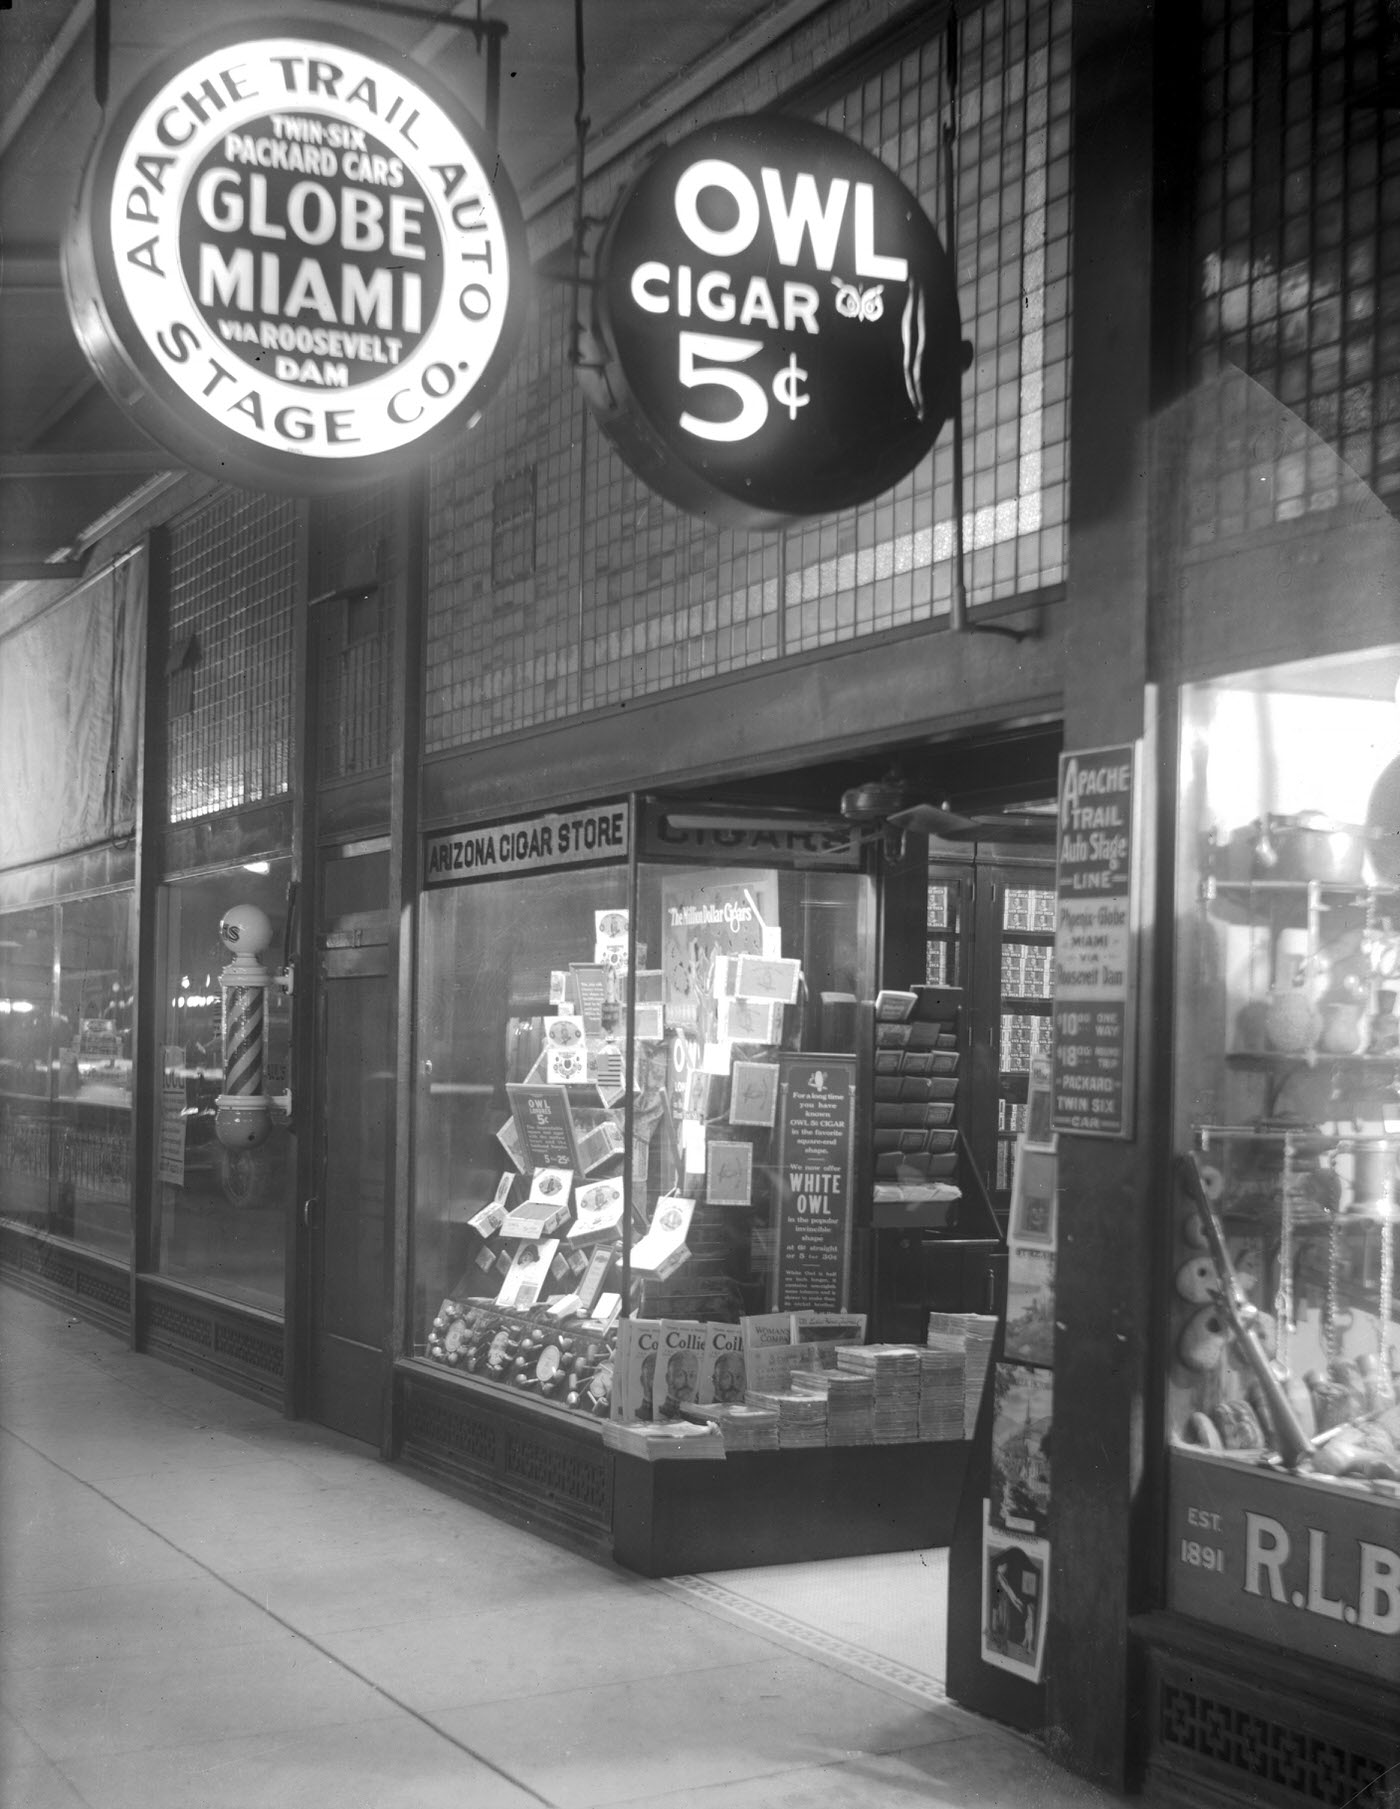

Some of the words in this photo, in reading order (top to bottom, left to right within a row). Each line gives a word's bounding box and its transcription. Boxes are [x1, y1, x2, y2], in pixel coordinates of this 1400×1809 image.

[225, 134, 337, 178] PACKARD
[342, 149, 403, 188] CARS
[126, 63, 259, 279] APACHE
[270, 57, 421, 150] TRAIL
[429, 162, 493, 322] AUTO
[197, 167, 426, 260] GLOBE
[674, 158, 908, 282] OWL
[199, 243, 422, 333] MIAMI
[631, 260, 820, 334] CIGAR
[218, 319, 259, 344] VIA
[260, 321, 402, 365] ROOSEVELT
[275, 356, 349, 387] DAM
[157, 321, 361, 446] STAGE
[386, 360, 470, 424] CO.
[1061, 758, 1130, 830] APACHE
[1071, 806, 1123, 830] TRAIL
[430, 836, 497, 873] ARIZONA
[499, 826, 553, 862] CIGAR
[558, 812, 624, 853] STORE
[1061, 834, 1087, 863] Auto
[1089, 832, 1127, 871] Stage
[1073, 872, 1111, 890] LINE
[668, 908, 683, 926] The
[703, 904, 725, 923] Dollar
[1072, 935, 1108, 948] MIAMI
[1096, 1013, 1118, 1024] ONE
[1095, 1025, 1119, 1037] WAY
[1062, 1074, 1114, 1091] PACKARD
[528, 1099, 551, 1109] OWL
[792, 1091, 806, 1099] For
[811, 1092, 827, 1101] long
[799, 1102, 815, 1110] you
[1057, 1096, 1088, 1110] TWIN
[1091, 1098, 1114, 1113] SIX
[790, 1119, 809, 1127] OWL
[819, 1120, 845, 1128] CIGAR
[814, 1129, 843, 1137] favorite
[1071, 1116, 1099, 1128] CAR
[797, 1138, 837, 1146] square-end
[790, 1163, 803, 1171] We
[823, 1164, 842, 1172] offer
[790, 1172, 841, 1194] WHITE
[797, 1193, 831, 1215] OWL
[810, 1217, 839, 1225] popular
[1188, 1507, 1222, 1532] EST.
[1181, 1539, 1224, 1573] 1891
